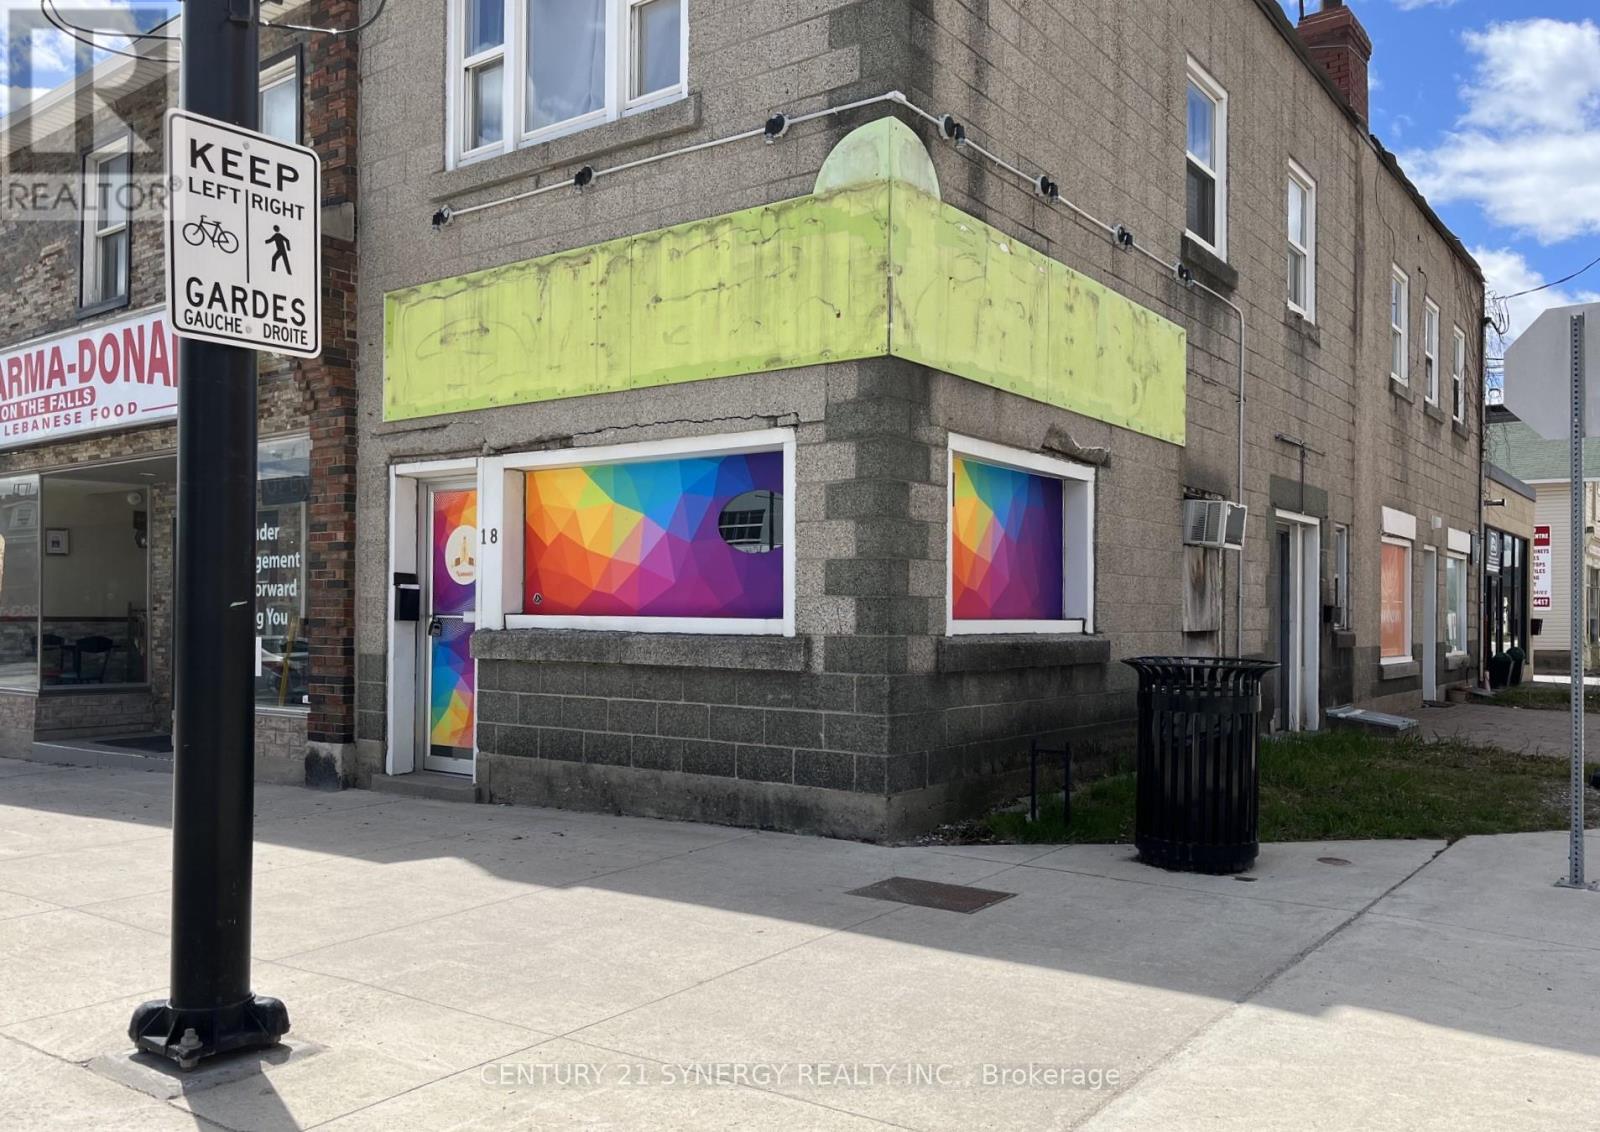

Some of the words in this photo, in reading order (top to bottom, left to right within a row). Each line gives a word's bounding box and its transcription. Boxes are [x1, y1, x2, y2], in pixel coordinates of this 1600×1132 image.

[190, 138, 299, 192] KEEP
[189, 176, 241, 204] LEFT
[251, 193, 305, 221] RIGHT
[186, 276, 306, 327] GARDES
[184, 308, 243, 334] GAUCHE
[263, 323, 309, 346] DROITE
[1, 404, 18, 420] ON
[21, 398, 46, 416] THE
[50, 388, 92, 411] FALLS
[4, 411, 82, 437] LEBANESE
[90, 401, 138, 422] FOOD
[256, 522, 280, 541] der
[481, 528, 498, 545] 18
[266, 607, 288, 626] You
